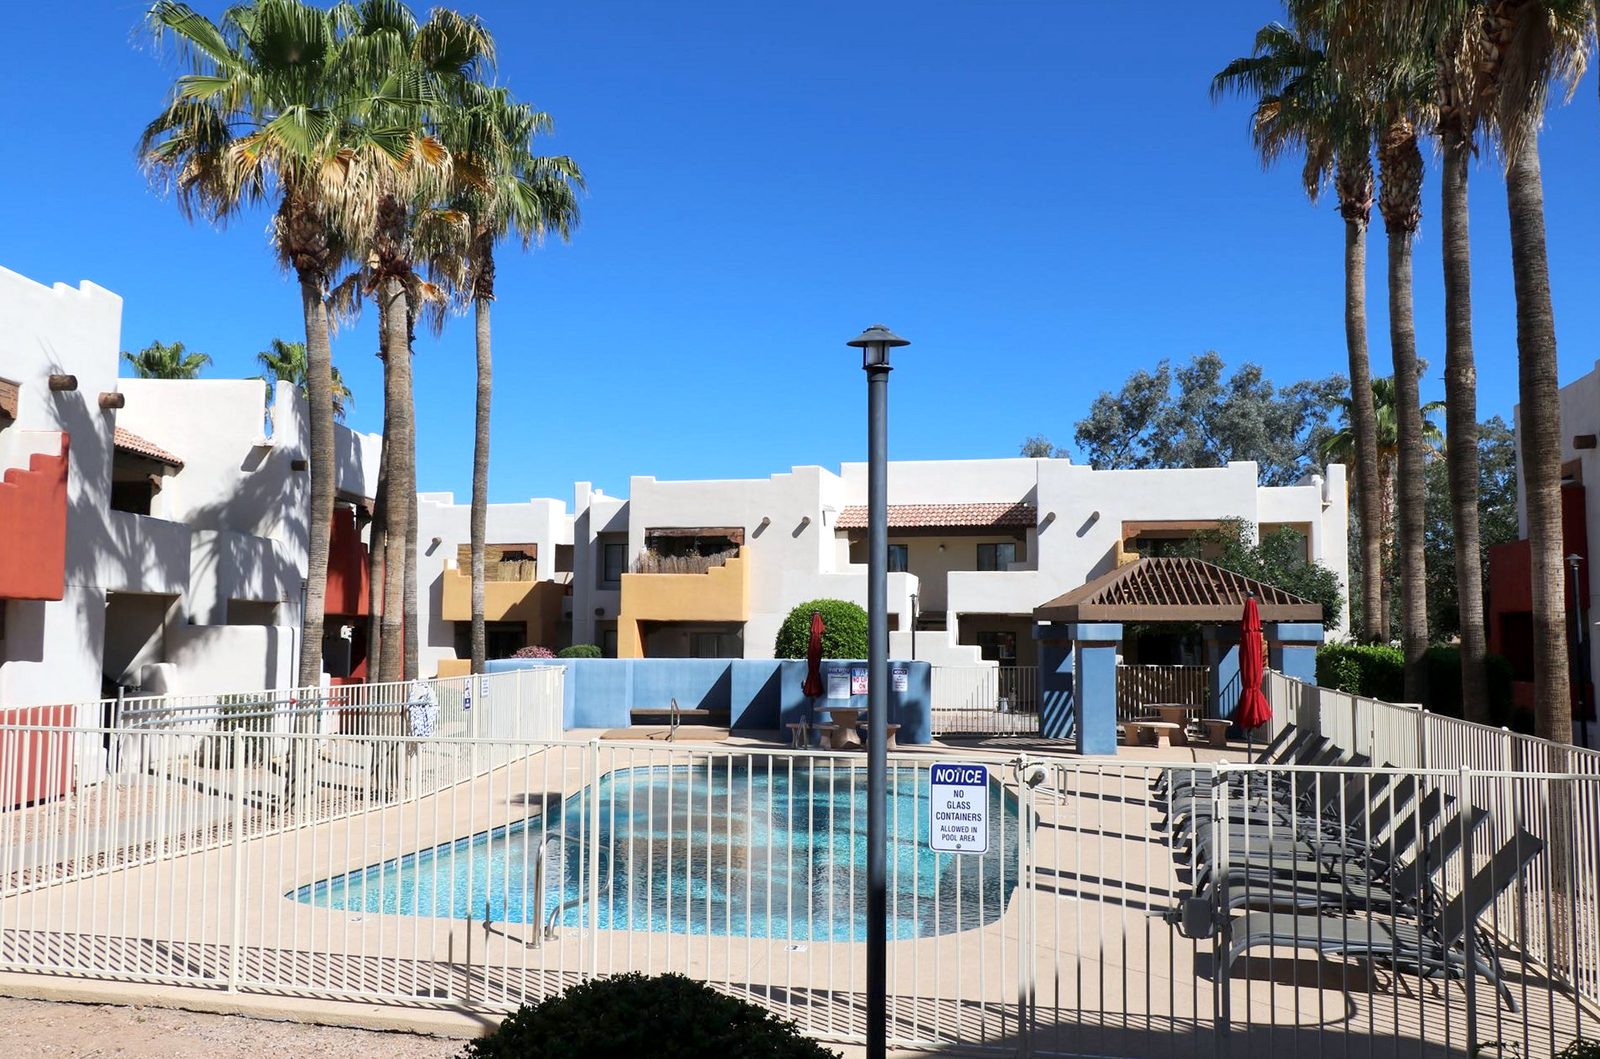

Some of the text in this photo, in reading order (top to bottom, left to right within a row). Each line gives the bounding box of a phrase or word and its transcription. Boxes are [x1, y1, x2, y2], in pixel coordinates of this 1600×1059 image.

[936, 768, 982, 783] NOTICE
[953, 789, 965, 798] NO
[946, 800, 971, 810] GLASS
[935, 811, 982, 822] CONTAINERS
[940, 825, 969, 833] ALLOWED
[941, 833, 976, 842] POOL AREA
